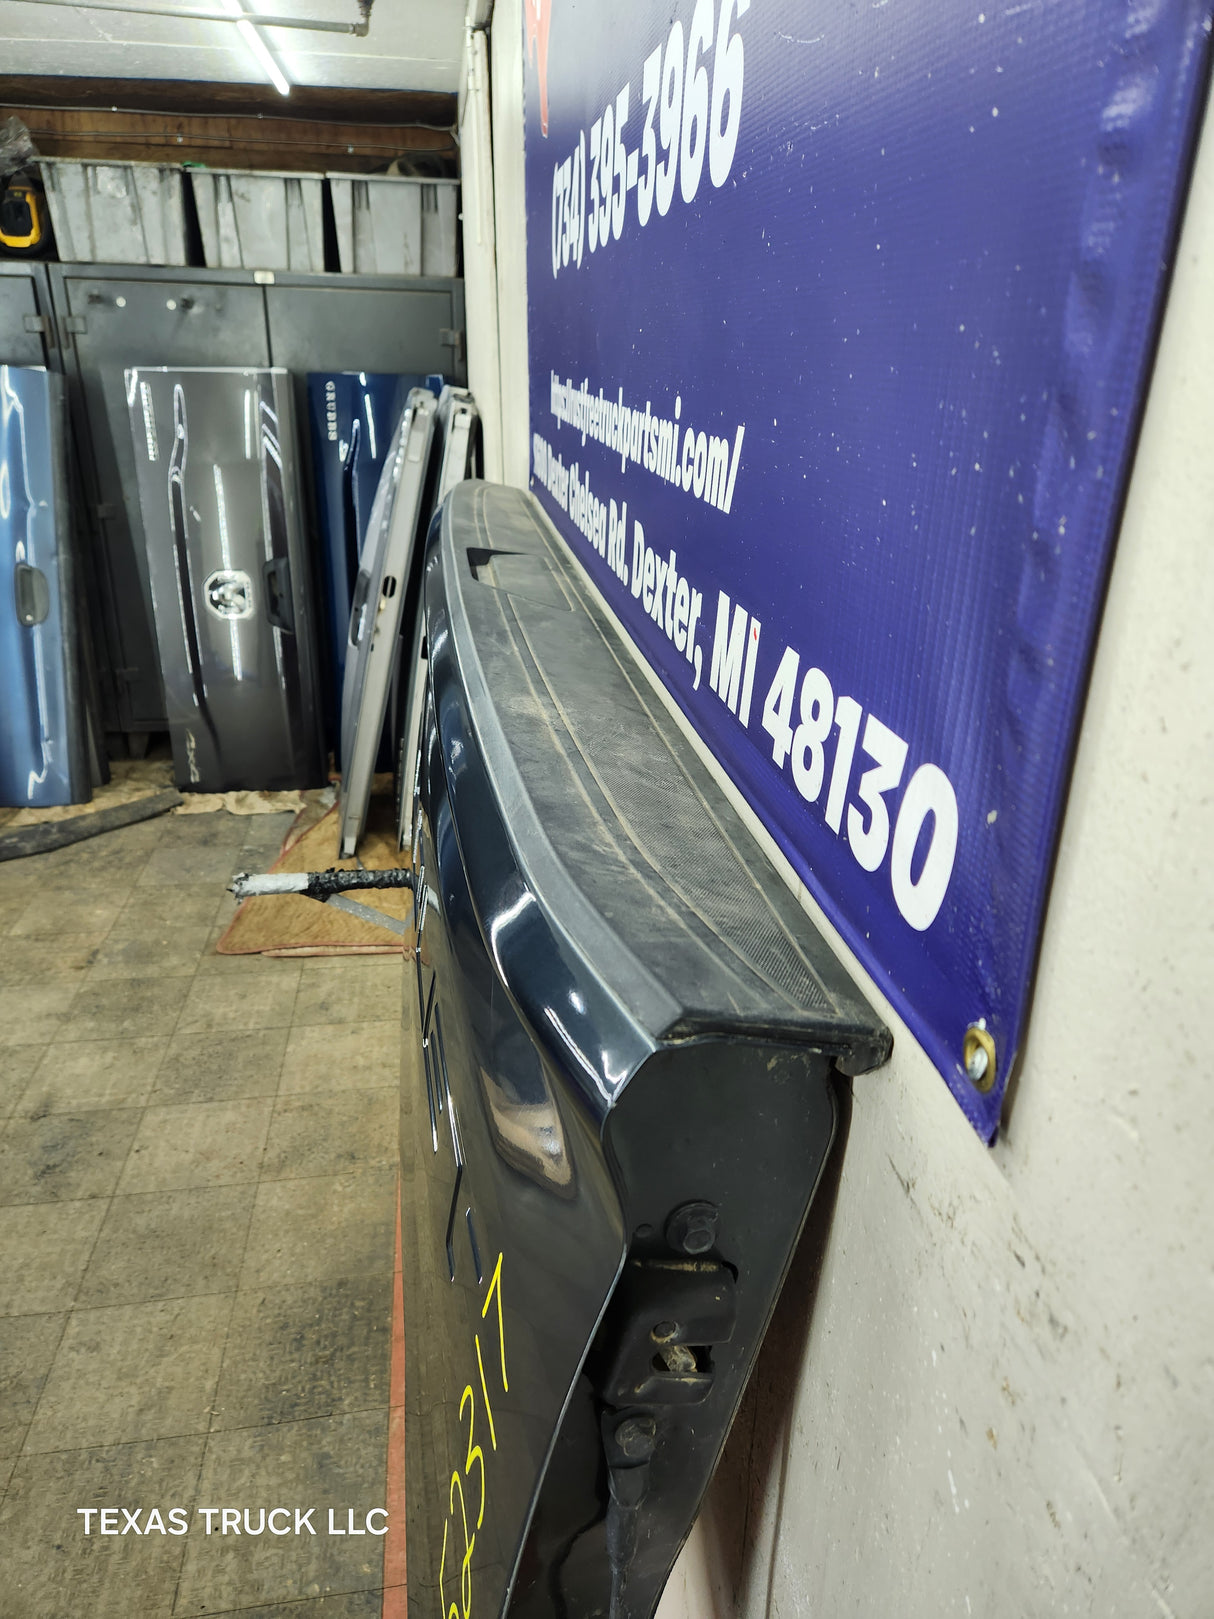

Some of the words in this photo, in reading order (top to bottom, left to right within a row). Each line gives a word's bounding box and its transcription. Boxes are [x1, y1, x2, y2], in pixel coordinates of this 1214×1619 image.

[552, 129, 586, 280] (734)
[588, 0, 750, 254] 395-3966
[569, 462, 607, 558] Chelsea
[607, 498, 628, 587] Rd.
[631, 519, 702, 691] Dexter,
[709, 590, 762, 729] MI
[761, 645, 959, 932] 48130
